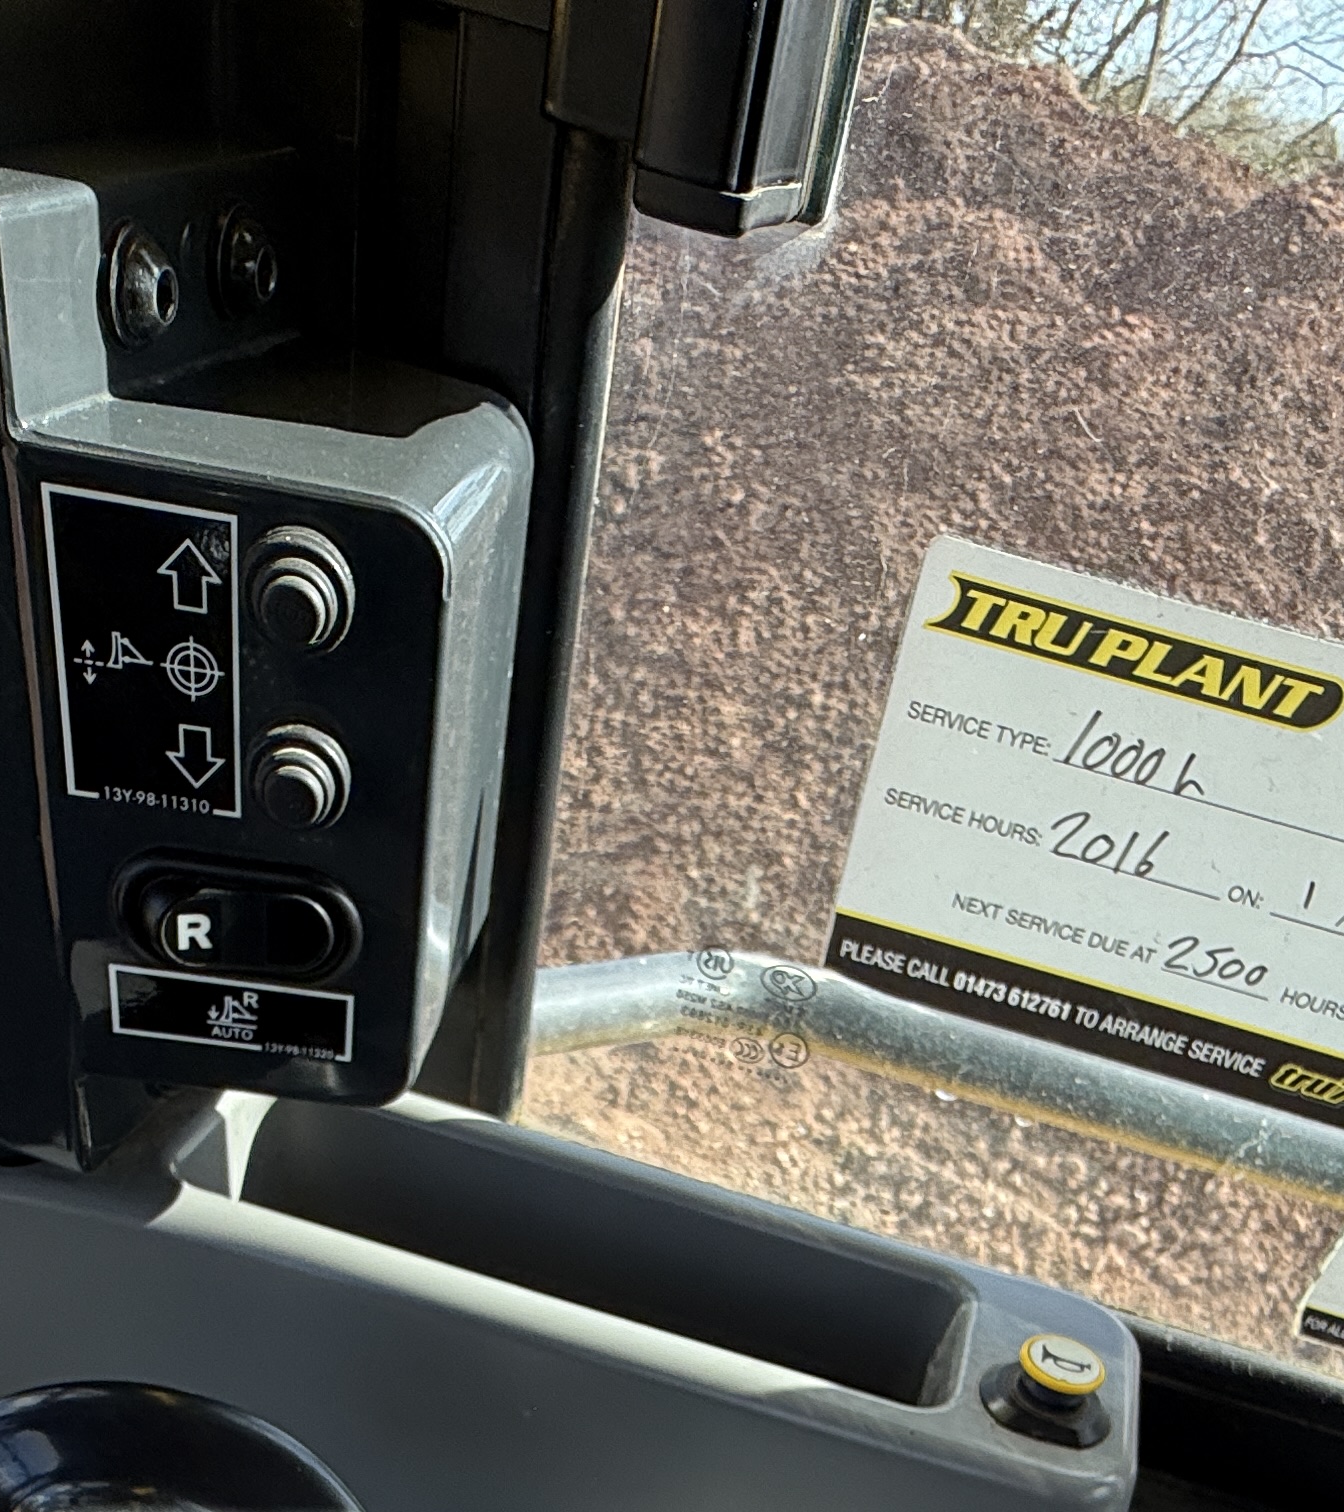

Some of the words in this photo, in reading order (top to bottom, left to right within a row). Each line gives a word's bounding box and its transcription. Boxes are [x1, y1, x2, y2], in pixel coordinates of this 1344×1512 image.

[960, 589, 1094, 657] TRU
[1087, 628, 1324, 720] PLANT
[907, 700, 993, 740] SERVICE
[996, 724, 1052, 757] TYPE:
[1063, 710, 1166, 787] 1000
[104, 786, 210, 814] 13Y-98-11310
[884, 787, 966, 825] SERVICE
[967, 813, 1043, 847] HOURS:
[1049, 811, 1170, 878] 2016
[1227, 884, 1264, 910] ON:
[176, 913, 213, 950] R
[951, 893, 1003, 921] NEXT
[1005, 909, 1086, 945] SERVICE
[1087, 931, 1131, 957] DUE
[1130, 942, 1158, 965] AT
[1163, 935, 1269, 988] 2500
[243, 991, 259, 1008] R
[839, 938, 906, 975] PLEASE
[907, 957, 951, 988] CALL
[952, 971, 1008, 1004] 01473
[1007, 986, 1073, 1022] 612761
[1074, 1005, 1101, 1030] TO
[1098, 1013, 1190, 1056] ARRANGE
[1187, 1037, 1267, 1079] SERVICE
[211, 1026, 254, 1041] AUTO
